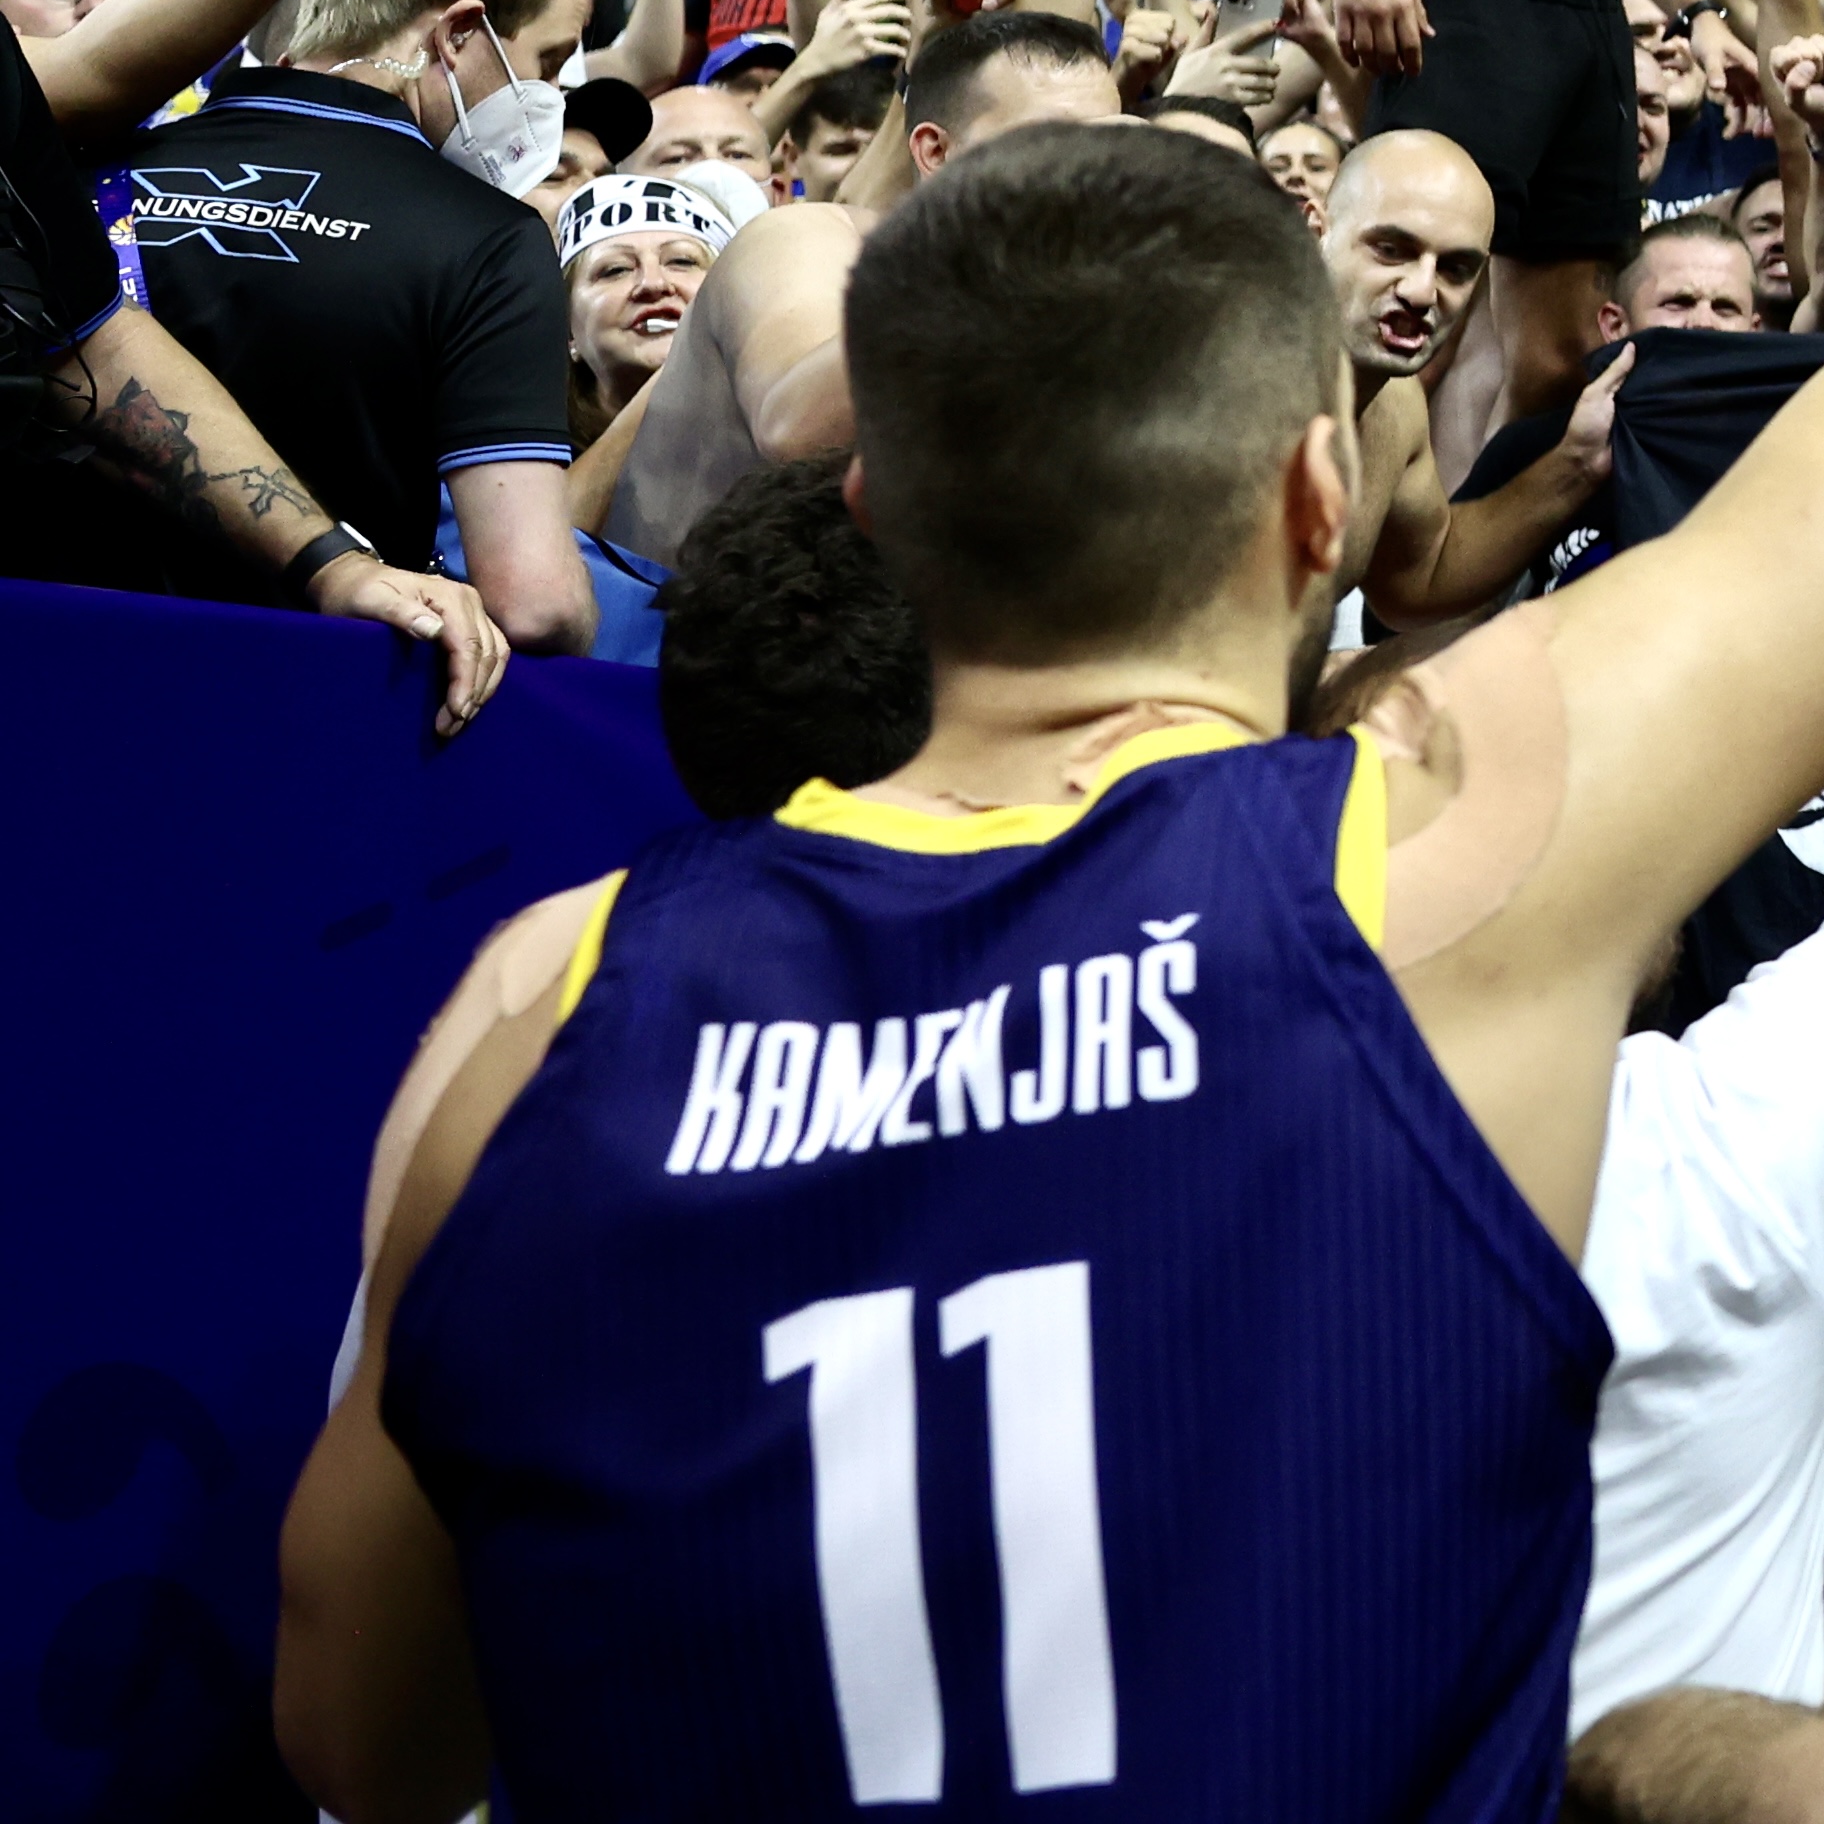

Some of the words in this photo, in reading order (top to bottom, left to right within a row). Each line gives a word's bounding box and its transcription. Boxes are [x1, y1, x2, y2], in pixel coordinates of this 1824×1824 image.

[92, 197, 371, 242] NUNGSDIENST
[663, 912, 1201, 1175] KAMENJAŠ
[761, 1261, 1118, 1807] 11
